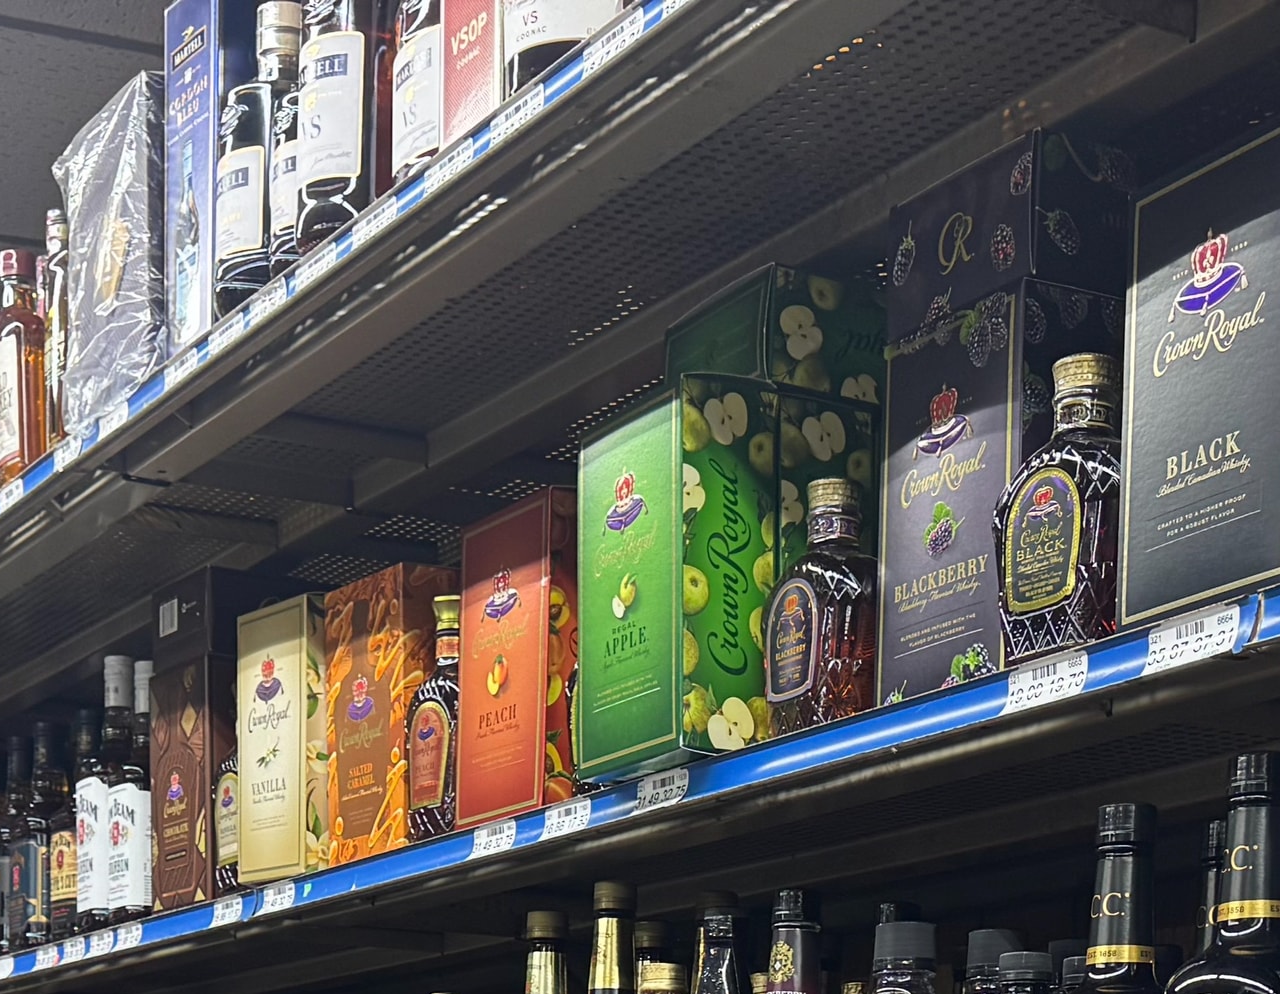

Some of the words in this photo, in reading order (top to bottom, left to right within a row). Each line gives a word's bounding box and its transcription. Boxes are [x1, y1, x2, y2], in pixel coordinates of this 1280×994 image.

[522, 10, 538, 25] VS
[451, 11, 487, 55] VSOP
[1153, 327, 1208, 378] Crown
[1195, 292, 1262, 360] Royal
[1166, 430, 1241, 480] BLACK
[1221, 454, 1250, 474] Whisky
[901, 468, 941, 510] Crown
[934, 441, 983, 492] Royal
[706, 458, 751, 574] Royal
[1157, 515, 1183, 531] CRAFTED
[1194, 509, 1198, 517] A
[1167, 529, 1178, 537] FOR
[1186, 517, 1209, 531] ROBUST
[1211, 508, 1235, 522] FLAVOR
[1017, 538, 1065, 562] BLACK
[894, 554, 988, 604] BLACKBERRY
[706, 567, 750, 676] Crown
[604, 625, 646, 659] APPLE
[478, 703, 518, 730] PEACH
[347, 772, 376, 789] CARAMEL
[348, 762, 373, 778] SALTED
[251, 776, 287, 798] VANILLA
